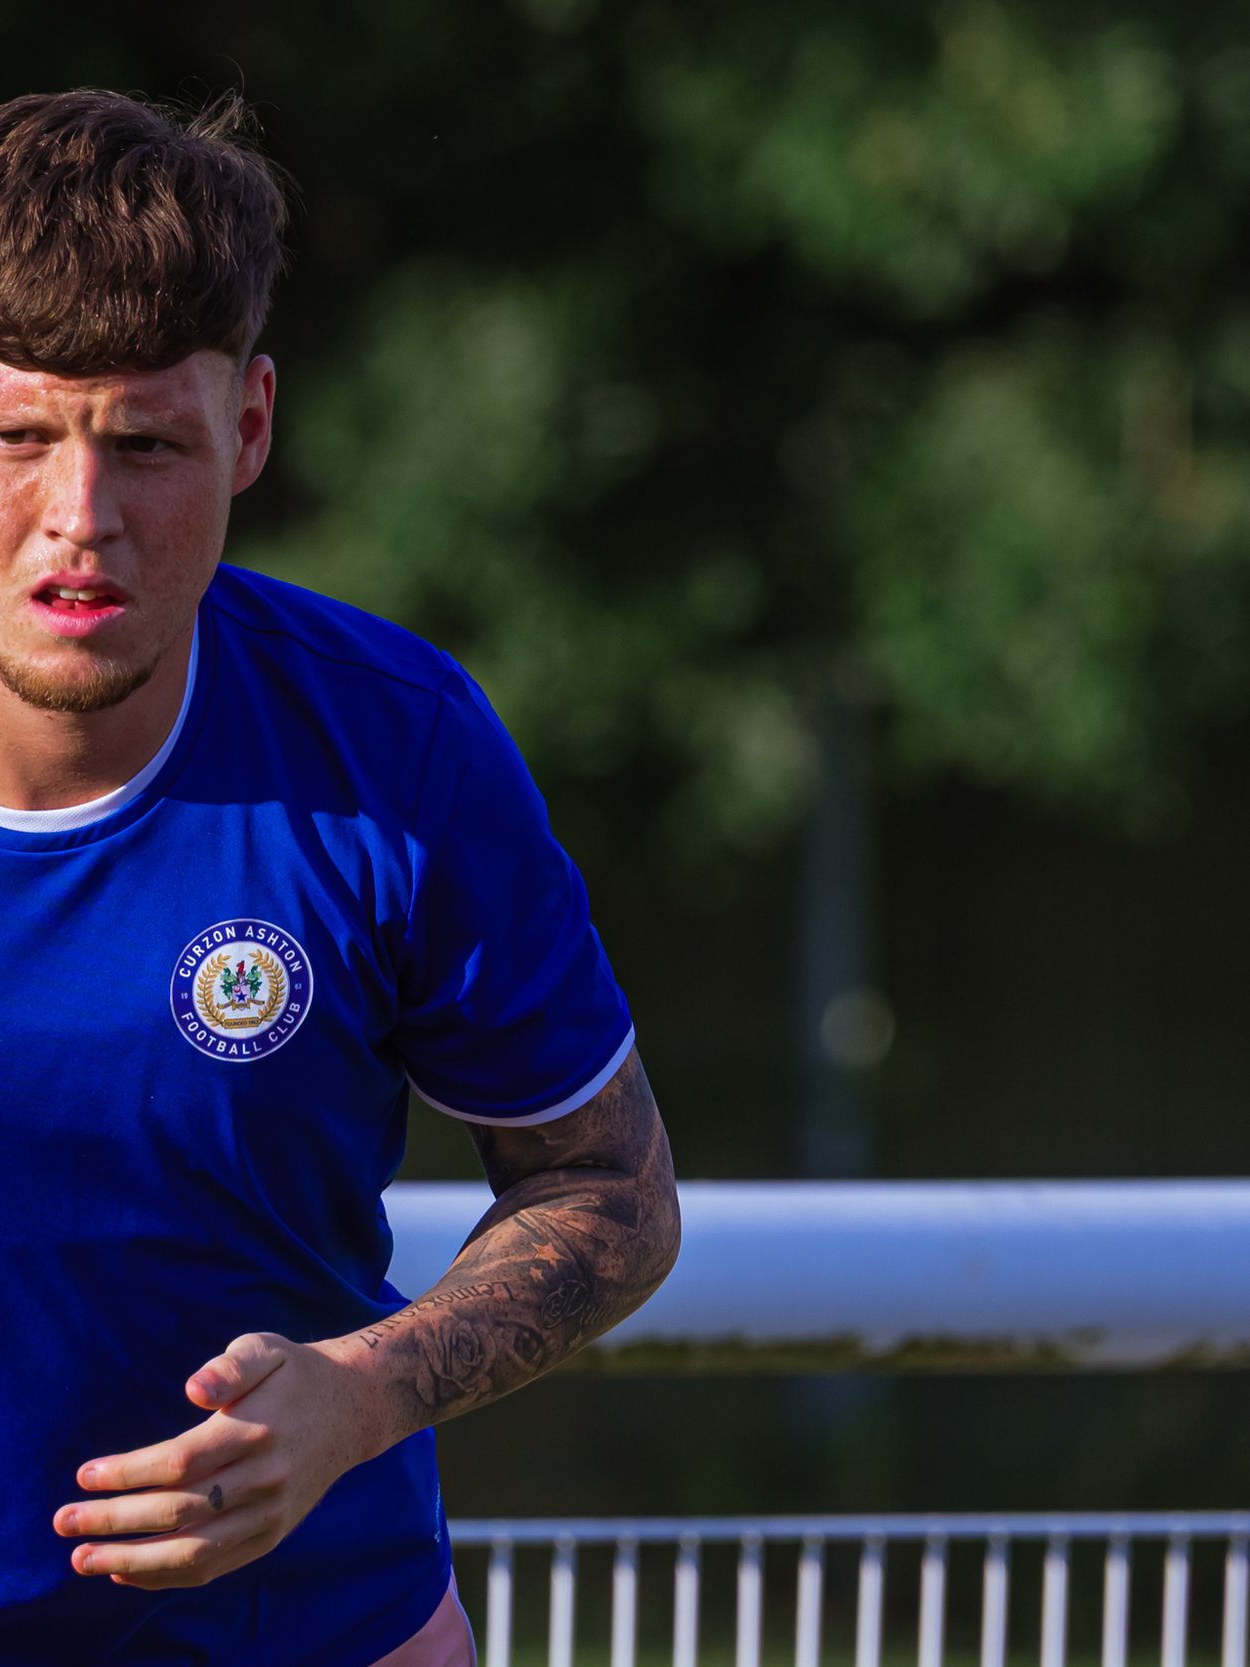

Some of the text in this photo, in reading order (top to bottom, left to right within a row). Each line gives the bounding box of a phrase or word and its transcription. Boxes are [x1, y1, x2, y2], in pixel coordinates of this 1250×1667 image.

[179, 925, 303, 978] CURZON ASHTON
[181, 1002, 301, 1055] FOOTBALL CLUB
